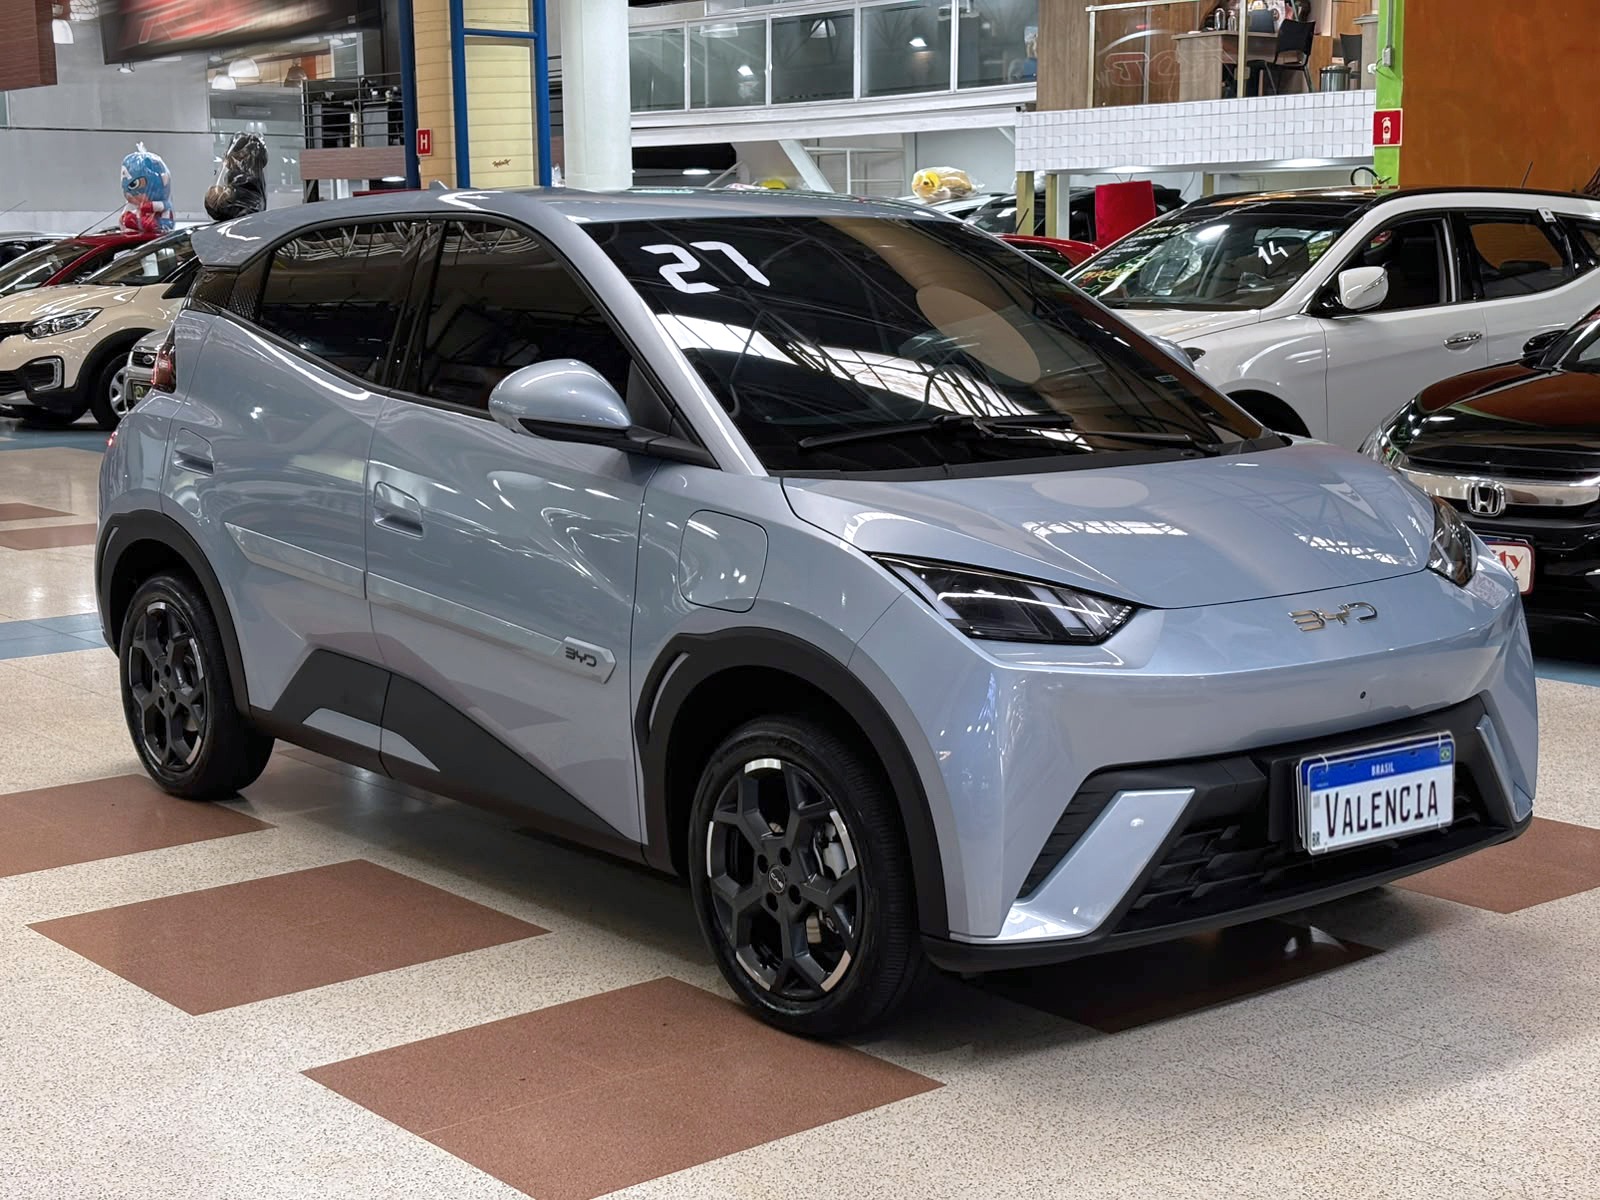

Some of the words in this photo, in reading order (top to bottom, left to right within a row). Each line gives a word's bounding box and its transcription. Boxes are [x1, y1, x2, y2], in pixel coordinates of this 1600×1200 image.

[420, 133, 428, 150] H
[1257, 240, 1289, 265] 14
[640, 241, 770, 294] 27
[1287, 601, 1378, 632] BYD
[565, 646, 598, 668] BYD
[1371, 762, 1395, 777] BRASIL
[1325, 779, 1439, 838] VALENCIA
[1312, 831, 1320, 847] BR
